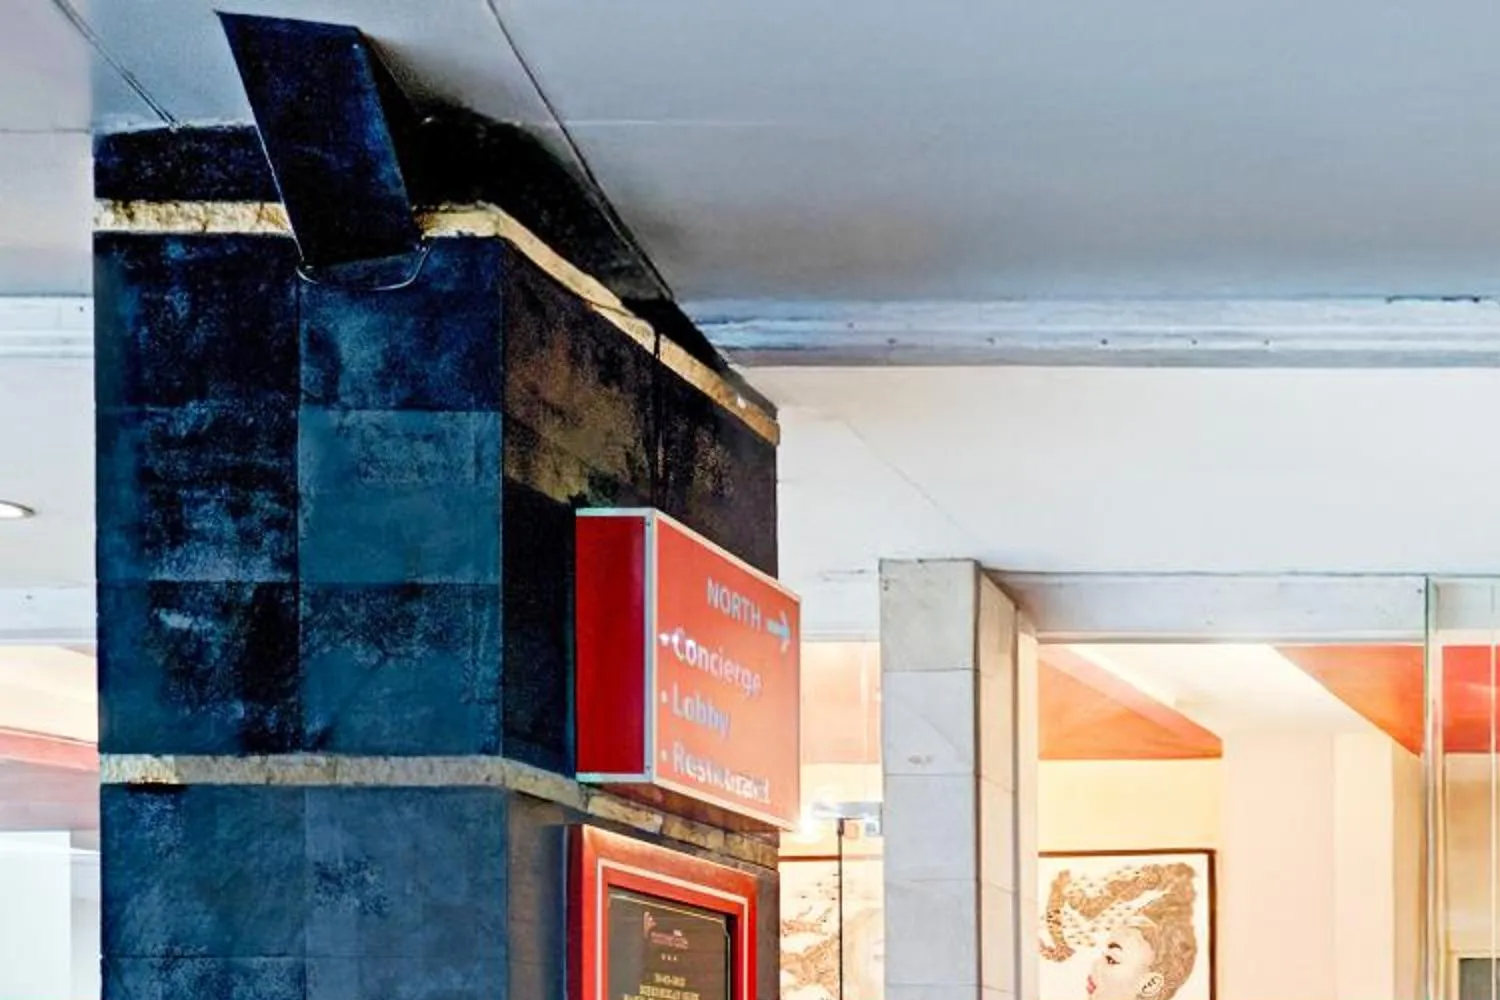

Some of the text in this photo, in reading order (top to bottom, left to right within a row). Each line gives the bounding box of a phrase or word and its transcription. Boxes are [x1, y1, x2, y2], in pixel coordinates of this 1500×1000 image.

[706, 577, 762, 629] NORTH
[671, 627, 763, 696] Concierge
[672, 684, 731, 740] Lobby
